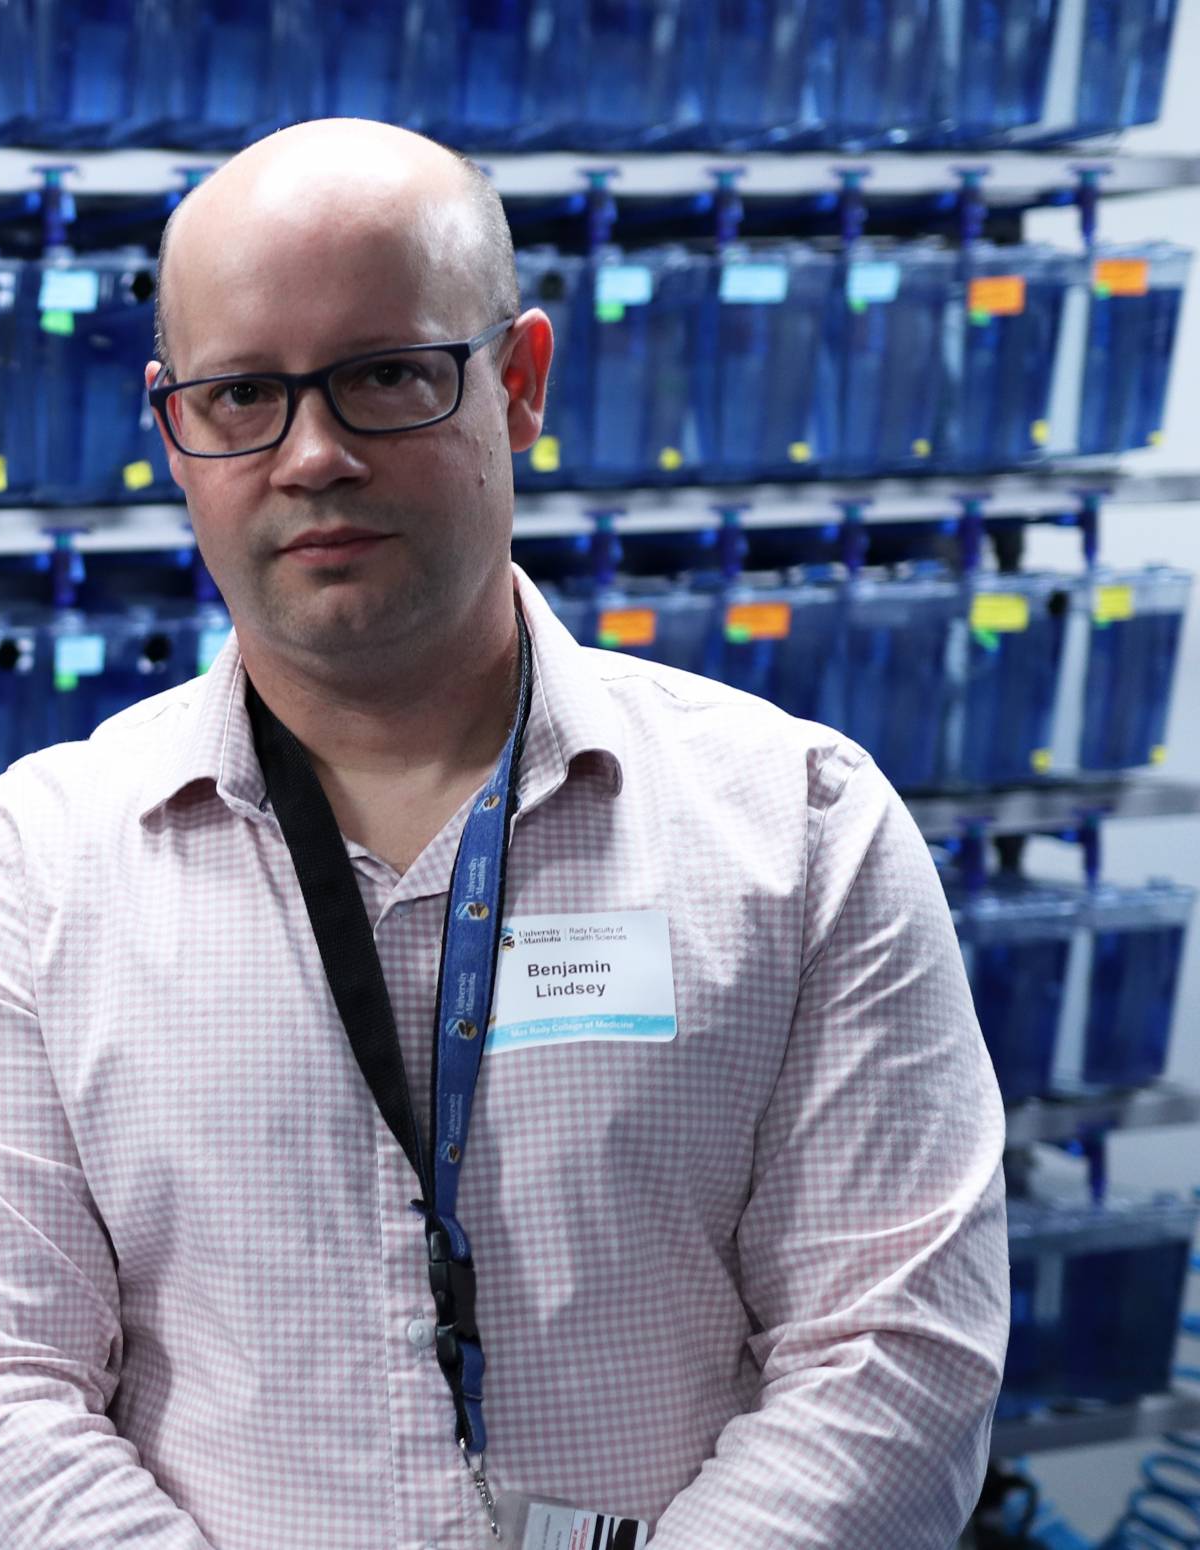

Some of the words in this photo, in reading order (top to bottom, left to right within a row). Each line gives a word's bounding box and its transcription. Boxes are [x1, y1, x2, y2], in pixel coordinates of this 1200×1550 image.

[519, 928, 560, 938] University
[569, 927, 587, 935] Rady
[589, 926, 614, 935] Faculty
[524, 936, 561, 945] Manitoba
[528, 960, 611, 978] Benjamin
[536, 981, 606, 998] Lindsey
[552, 1022, 583, 1032] College
[595, 1020, 634, 1029] Medicine
